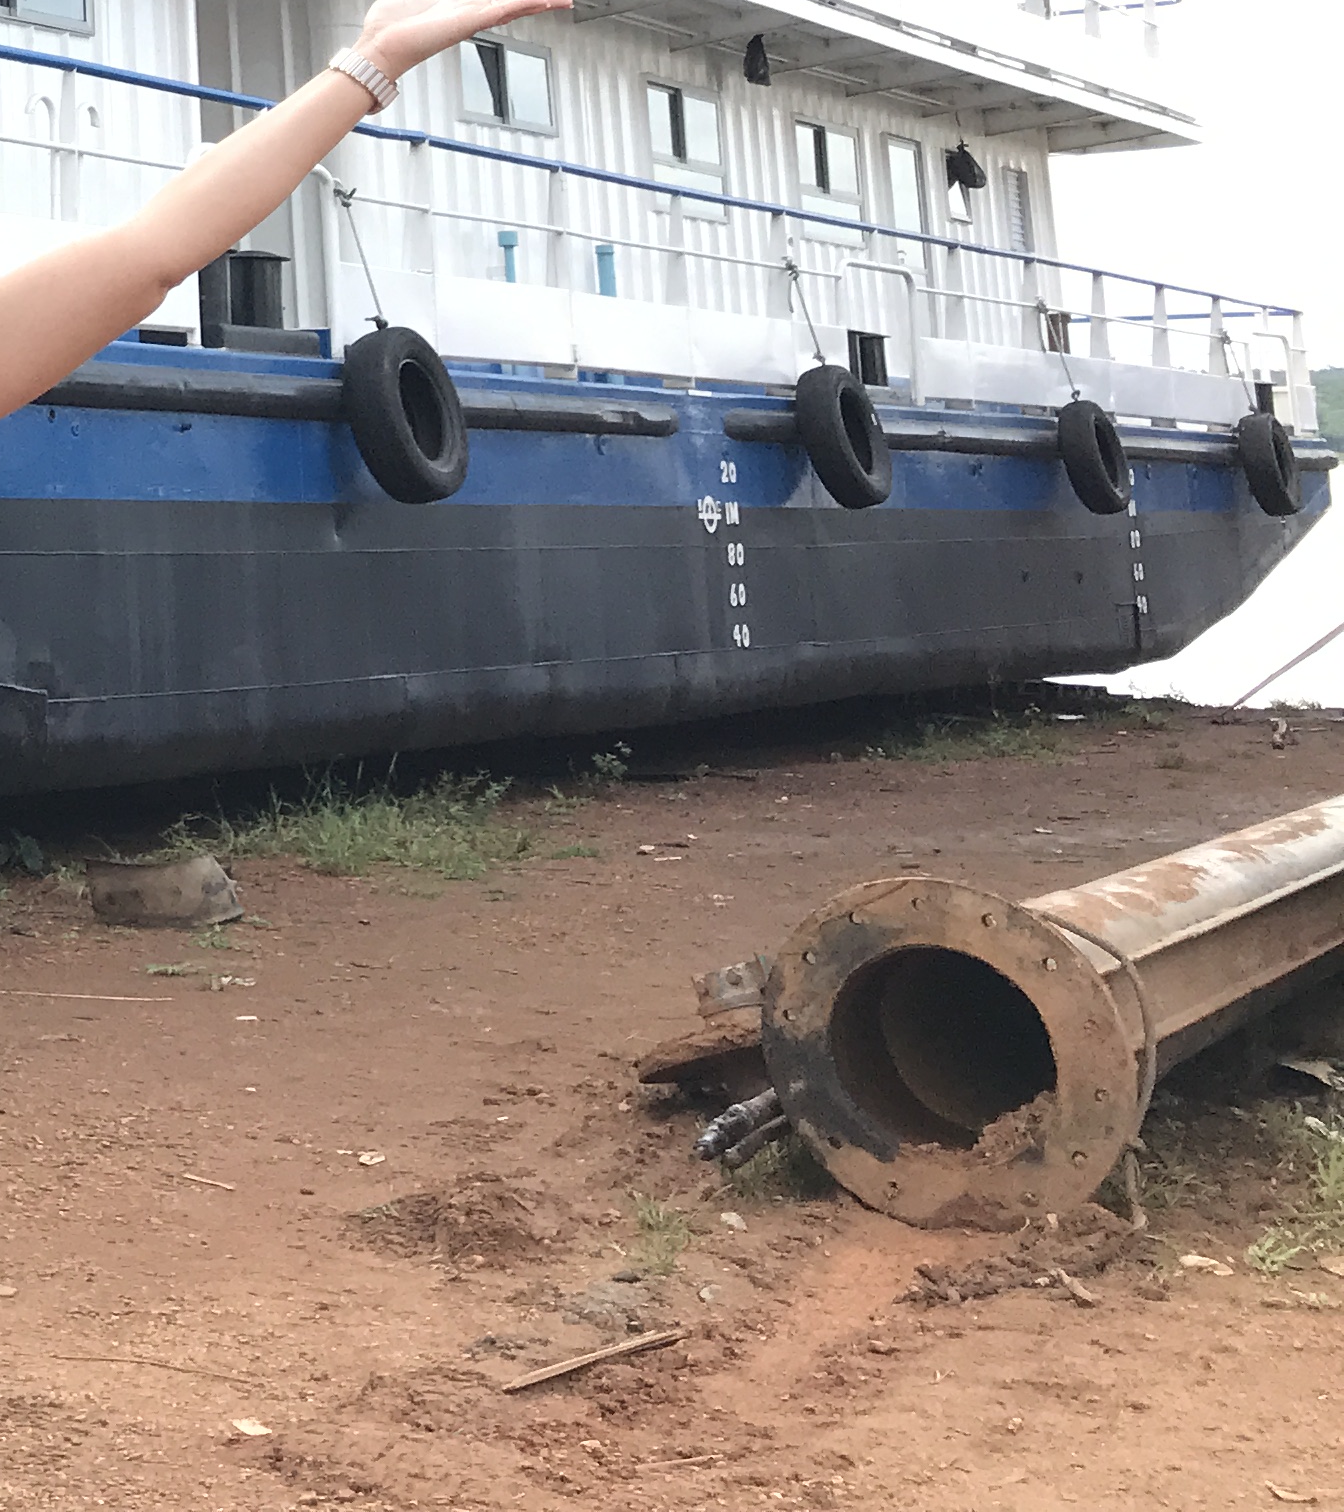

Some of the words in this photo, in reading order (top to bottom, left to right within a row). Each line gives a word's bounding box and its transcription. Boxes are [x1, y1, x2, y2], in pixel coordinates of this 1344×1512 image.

[720, 460, 737, 483] 20
[727, 543, 744, 566] 80
[730, 584, 746, 607] 60
[733, 624, 750, 648] 40
